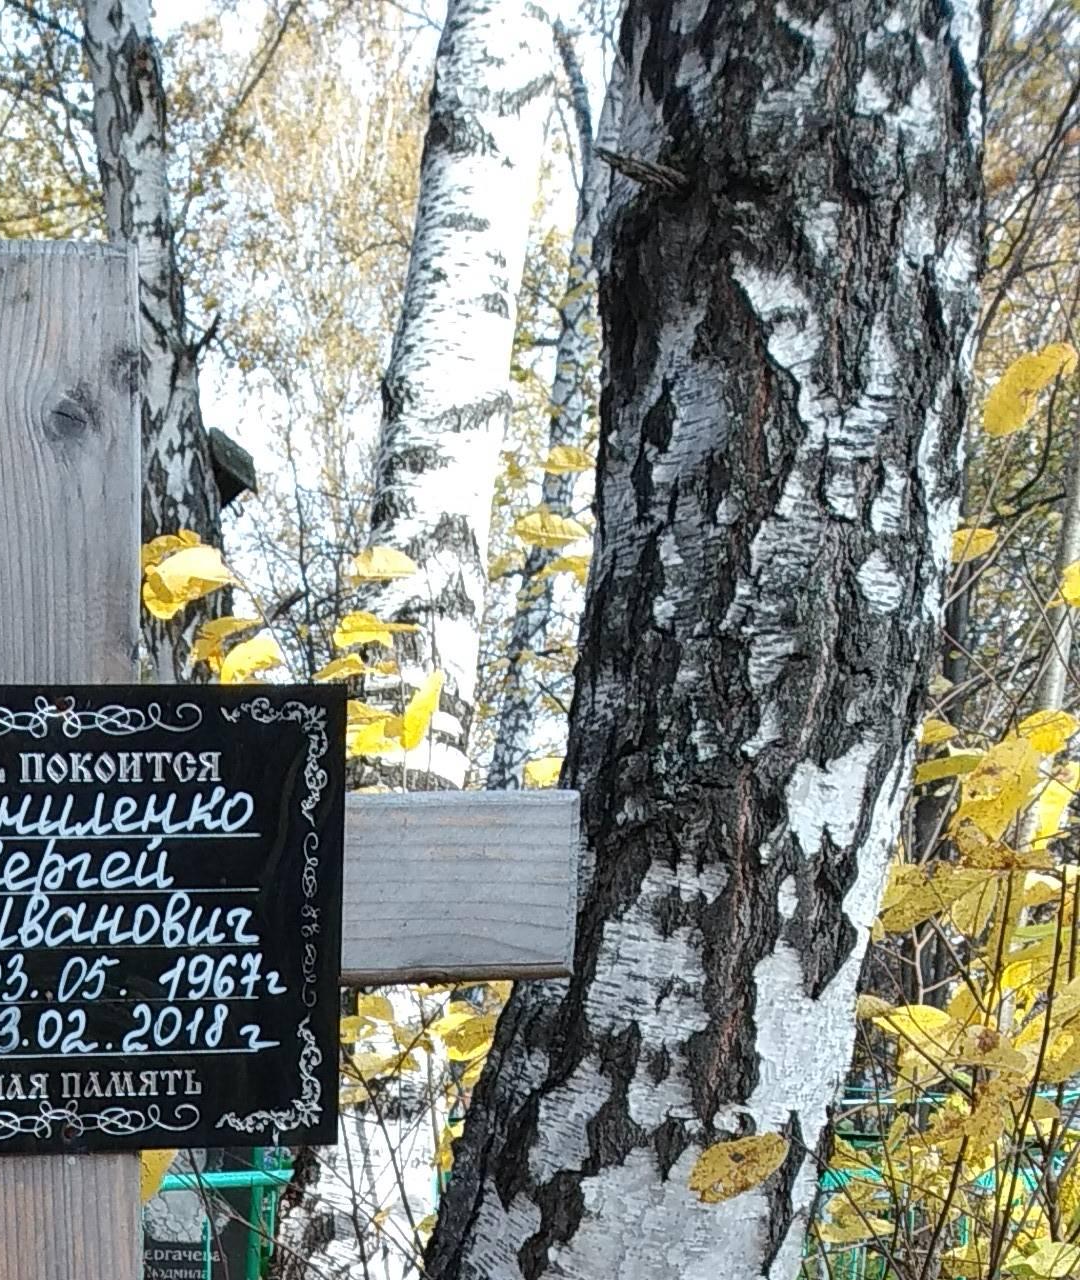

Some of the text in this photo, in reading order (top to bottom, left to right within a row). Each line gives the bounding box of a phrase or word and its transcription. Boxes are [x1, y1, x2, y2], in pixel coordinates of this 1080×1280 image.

[19, 751, 222, 784] ПОКОИТСЯ
[60, 1070, 203, 1099] ПАМЯТЬ
[143, 1249, 220, 1263] ергачева
